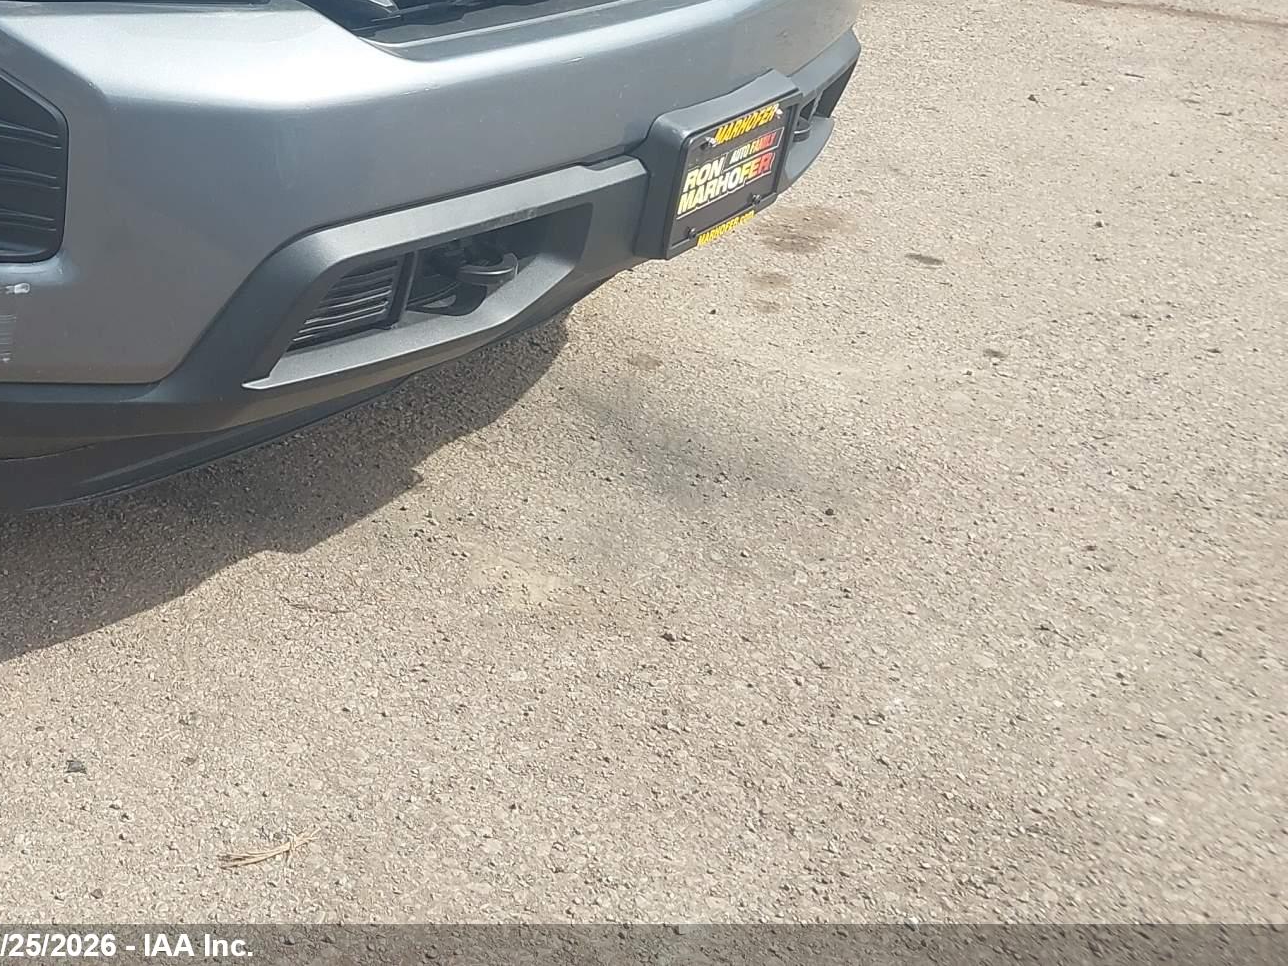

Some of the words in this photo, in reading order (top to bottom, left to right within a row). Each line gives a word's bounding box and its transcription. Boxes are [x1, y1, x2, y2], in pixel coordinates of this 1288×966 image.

[714, 103, 779, 145] MARHOFER
[677, 152, 773, 215] MARHOFER
[682, 156, 725, 193] RON
